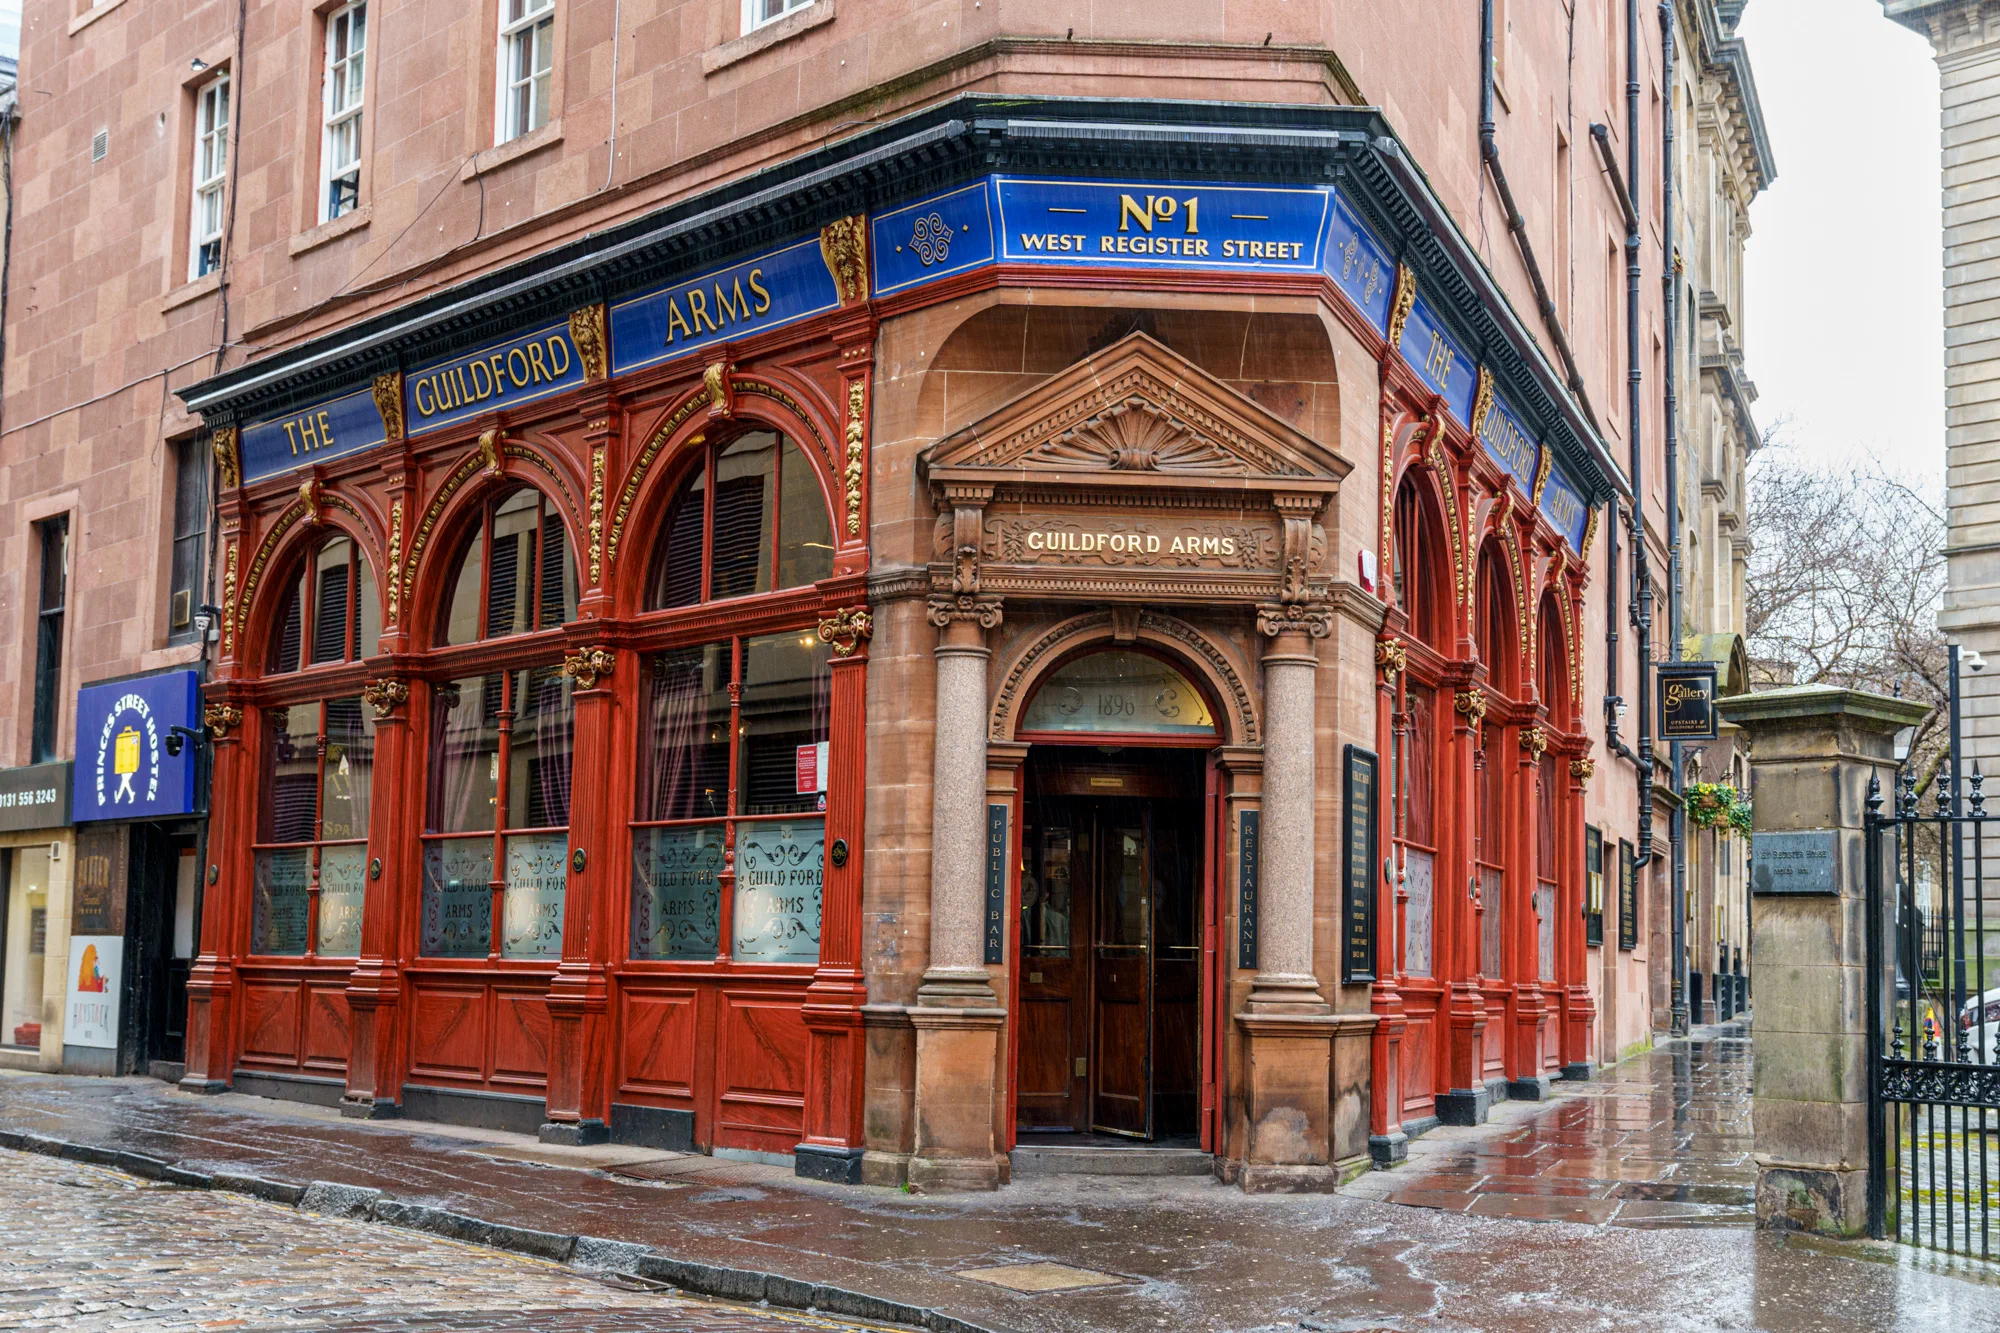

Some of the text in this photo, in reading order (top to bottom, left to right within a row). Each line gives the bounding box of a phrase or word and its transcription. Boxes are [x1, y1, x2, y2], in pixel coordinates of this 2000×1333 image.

[1021, 234, 1304, 259] WEST REGISTER STREET
[283, 268, 771, 455] THE GUILDFORD ARMS
[1424, 329, 1577, 533] THE GUILDFORD ARMS
[1027, 531, 1235, 556] GUILDFORD ARMS
[1665, 683, 1709, 713] gallery
[97, 694, 159, 807] PRINCES STREET HOSTEL
[19, 790, 34, 806] 556
[35, 788, 57, 804] 3243
[1773, 850, 1804, 859] REGISTER
[1806, 850, 1827, 859] HOUSE
[546, 876, 567, 891] FOR
[989, 819, 1002, 948] PUBLIC BAR
[1243, 825, 1254, 953] RESTAURANT
[445, 903, 473, 918] ARMS
[528, 903, 559, 918] ARMS
[661, 900, 695, 915] ARMS
[766, 897, 804, 914] ARMS
